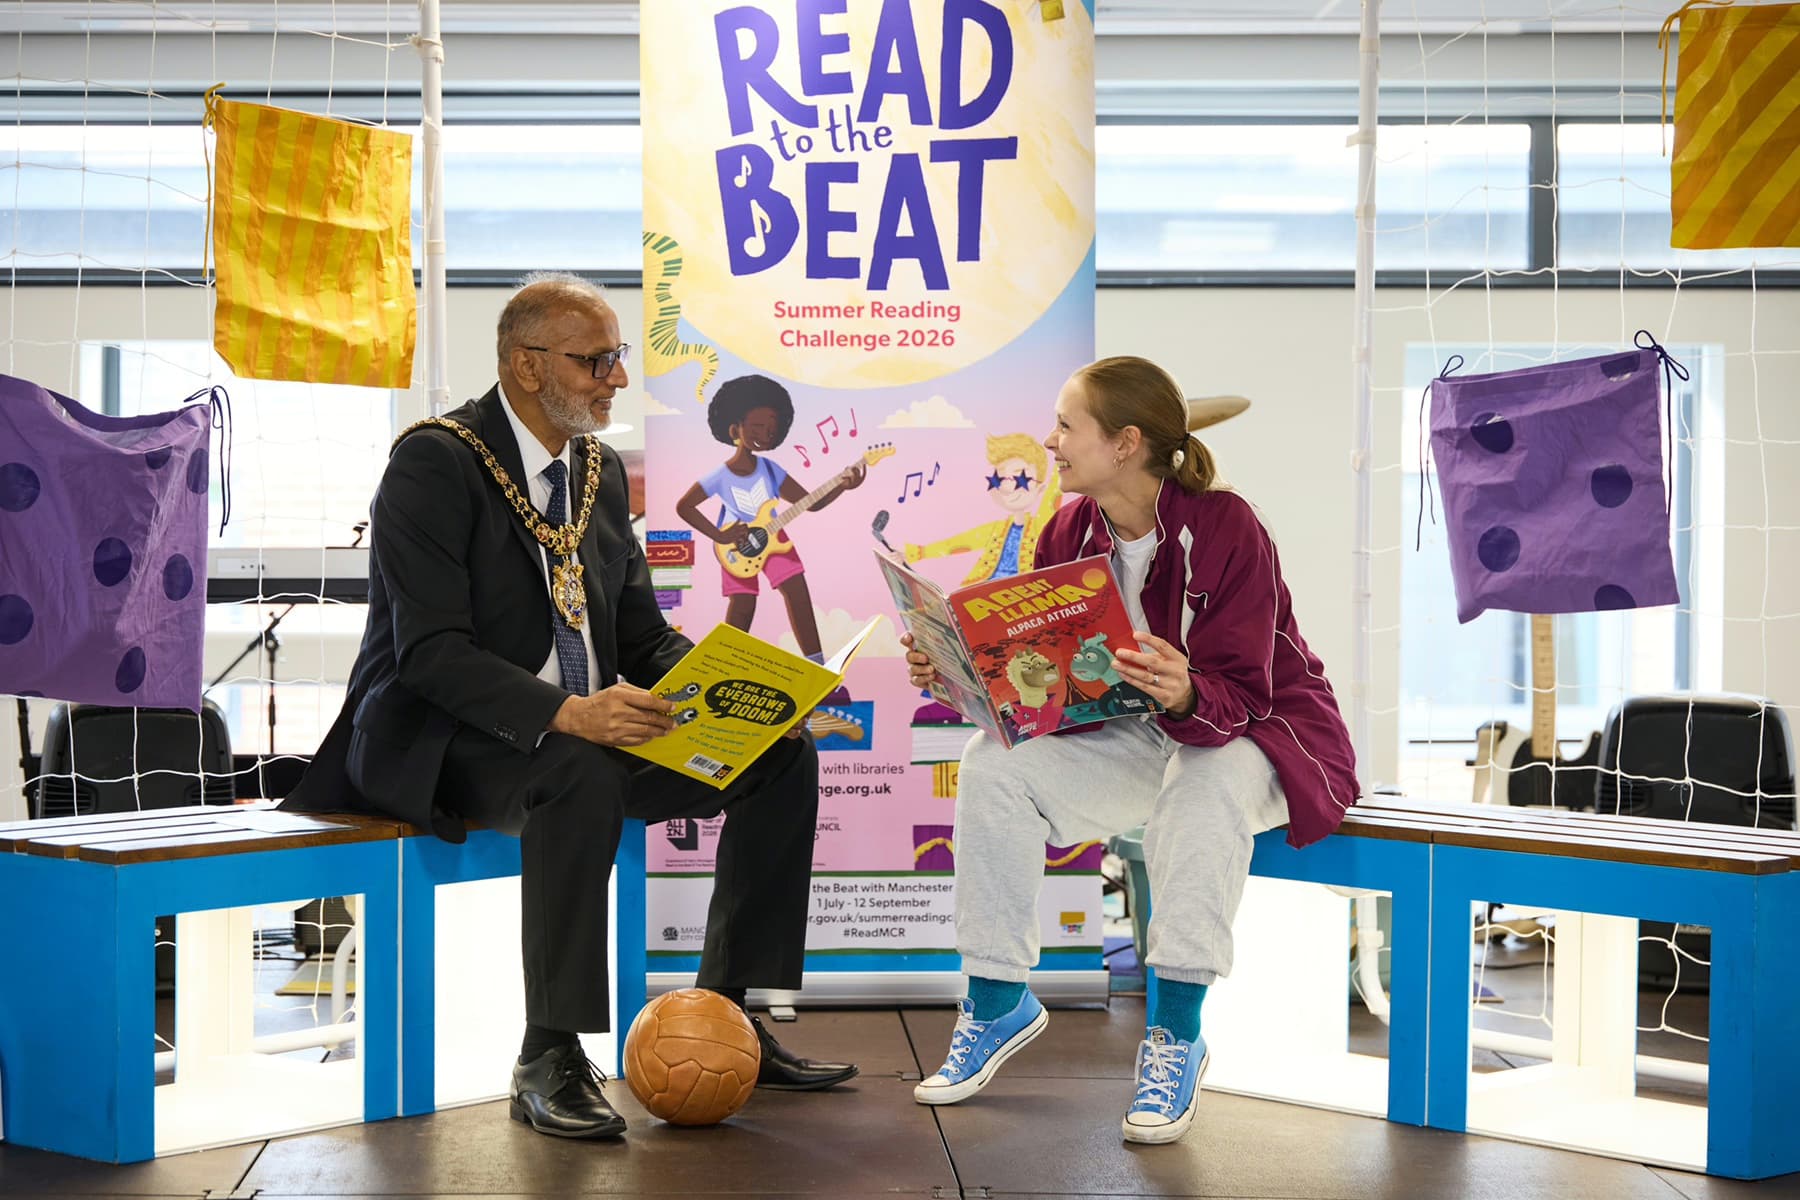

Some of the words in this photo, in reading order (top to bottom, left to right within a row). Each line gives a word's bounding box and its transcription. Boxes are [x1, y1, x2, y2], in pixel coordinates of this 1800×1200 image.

[714, 0, 1014, 137] READ
[770, 120, 813, 161] to
[825, 104, 893, 153] the
[715, 136, 1018, 290] BEAT
[774, 301, 864, 318] Summer
[871, 300, 961, 322] Reading
[780, 329, 891, 351] Challenge
[896, 329, 955, 347] 2026
[963, 578, 1053, 623] AGENT
[998, 584, 1097, 624] LLAMA
[1006, 616, 1046, 638] ALPACA
[1046, 601, 1089, 622] ATTACK!
[715, 686, 787, 712] EYEBROWS
[731, 681, 745, 690] WE
[761, 689, 779, 699] THE
[727, 702, 779, 725] DOOM!
[822, 762, 850, 775] with
[853, 763, 905, 775] libraries
[818, 782, 892, 797] nge.org.uk
[666, 819, 684, 829] ALL
[816, 823, 841, 831] UNCIL
[812, 883, 831, 893] the
[833, 883, 858, 893] Beat
[861, 883, 885, 893] with
[887, 883, 953, 893] Manchester
[817, 898, 822, 908] 1
[824, 898, 845, 910] July
[854, 898, 866, 908] 12
[869, 898, 931, 910] September
[807, 913, 953, 926] r.gov.uk/summerreadingc
[843, 928, 906, 938] #ReadMCR
